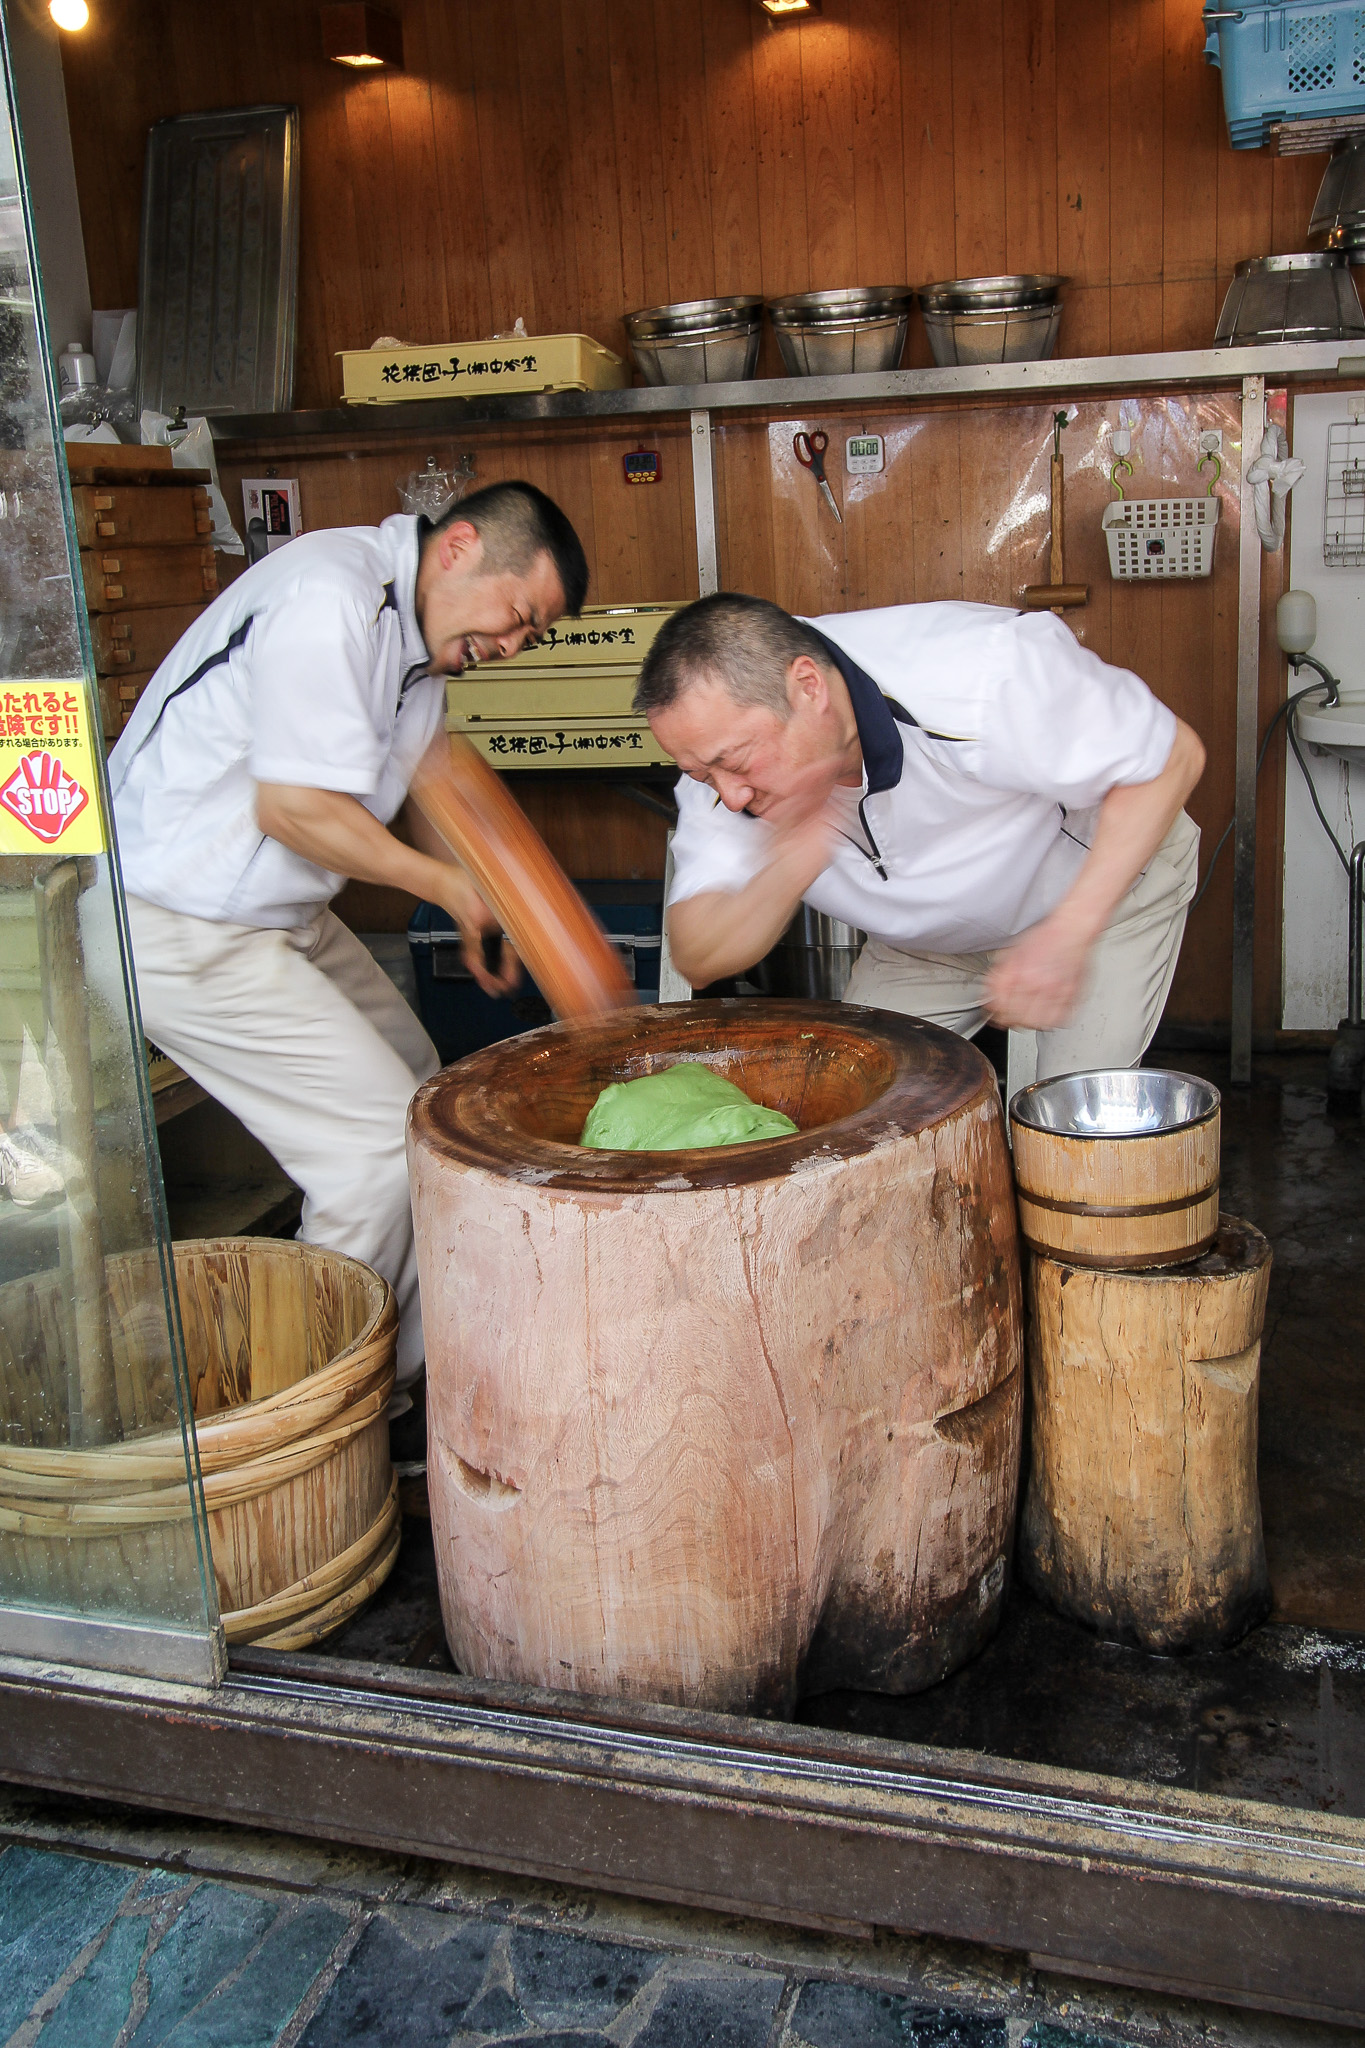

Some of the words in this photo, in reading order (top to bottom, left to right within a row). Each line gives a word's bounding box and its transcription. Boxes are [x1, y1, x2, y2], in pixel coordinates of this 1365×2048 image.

[0, 691, 79, 713] たれると
[16, 786, 73, 816] STOP
